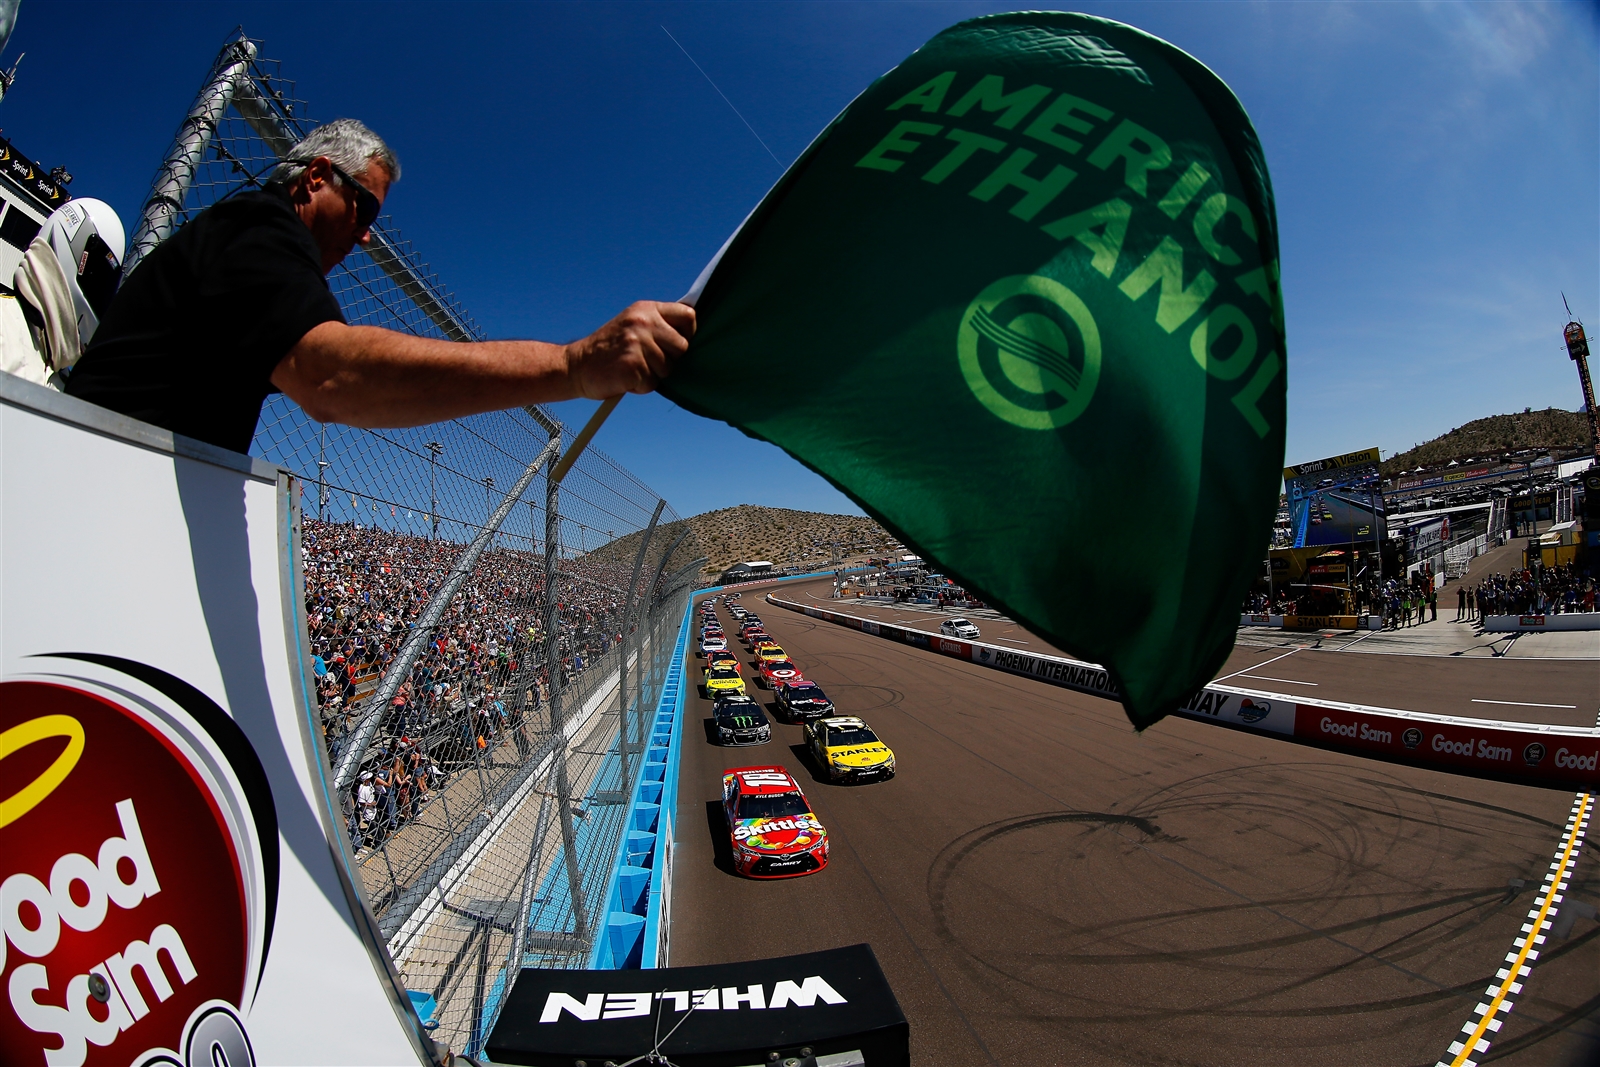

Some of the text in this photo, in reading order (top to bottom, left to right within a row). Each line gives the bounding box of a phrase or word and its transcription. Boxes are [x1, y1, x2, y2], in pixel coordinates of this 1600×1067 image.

[12, 160, 28, 177] Sprint
[38, 180, 53, 196] Sprint
[854, 120, 1283, 440] ETHANOL
[1300, 451, 1371, 475] Sprint Vision
[1297, 617, 1342, 628] STANLEY
[994, 651, 1035, 674] PHOENIX
[1320, 716, 1392, 744] Good Sam
[831, 747, 888, 759] STANLEY
[1431, 733, 1512, 762] Good Sam
[1555, 747, 1599, 771] Good
[733, 818, 823, 841] Skittles
[0, 798, 161, 976] ood
[9, 924, 198, 1067] Sam
[539, 975, 849, 1023] WHELEN
